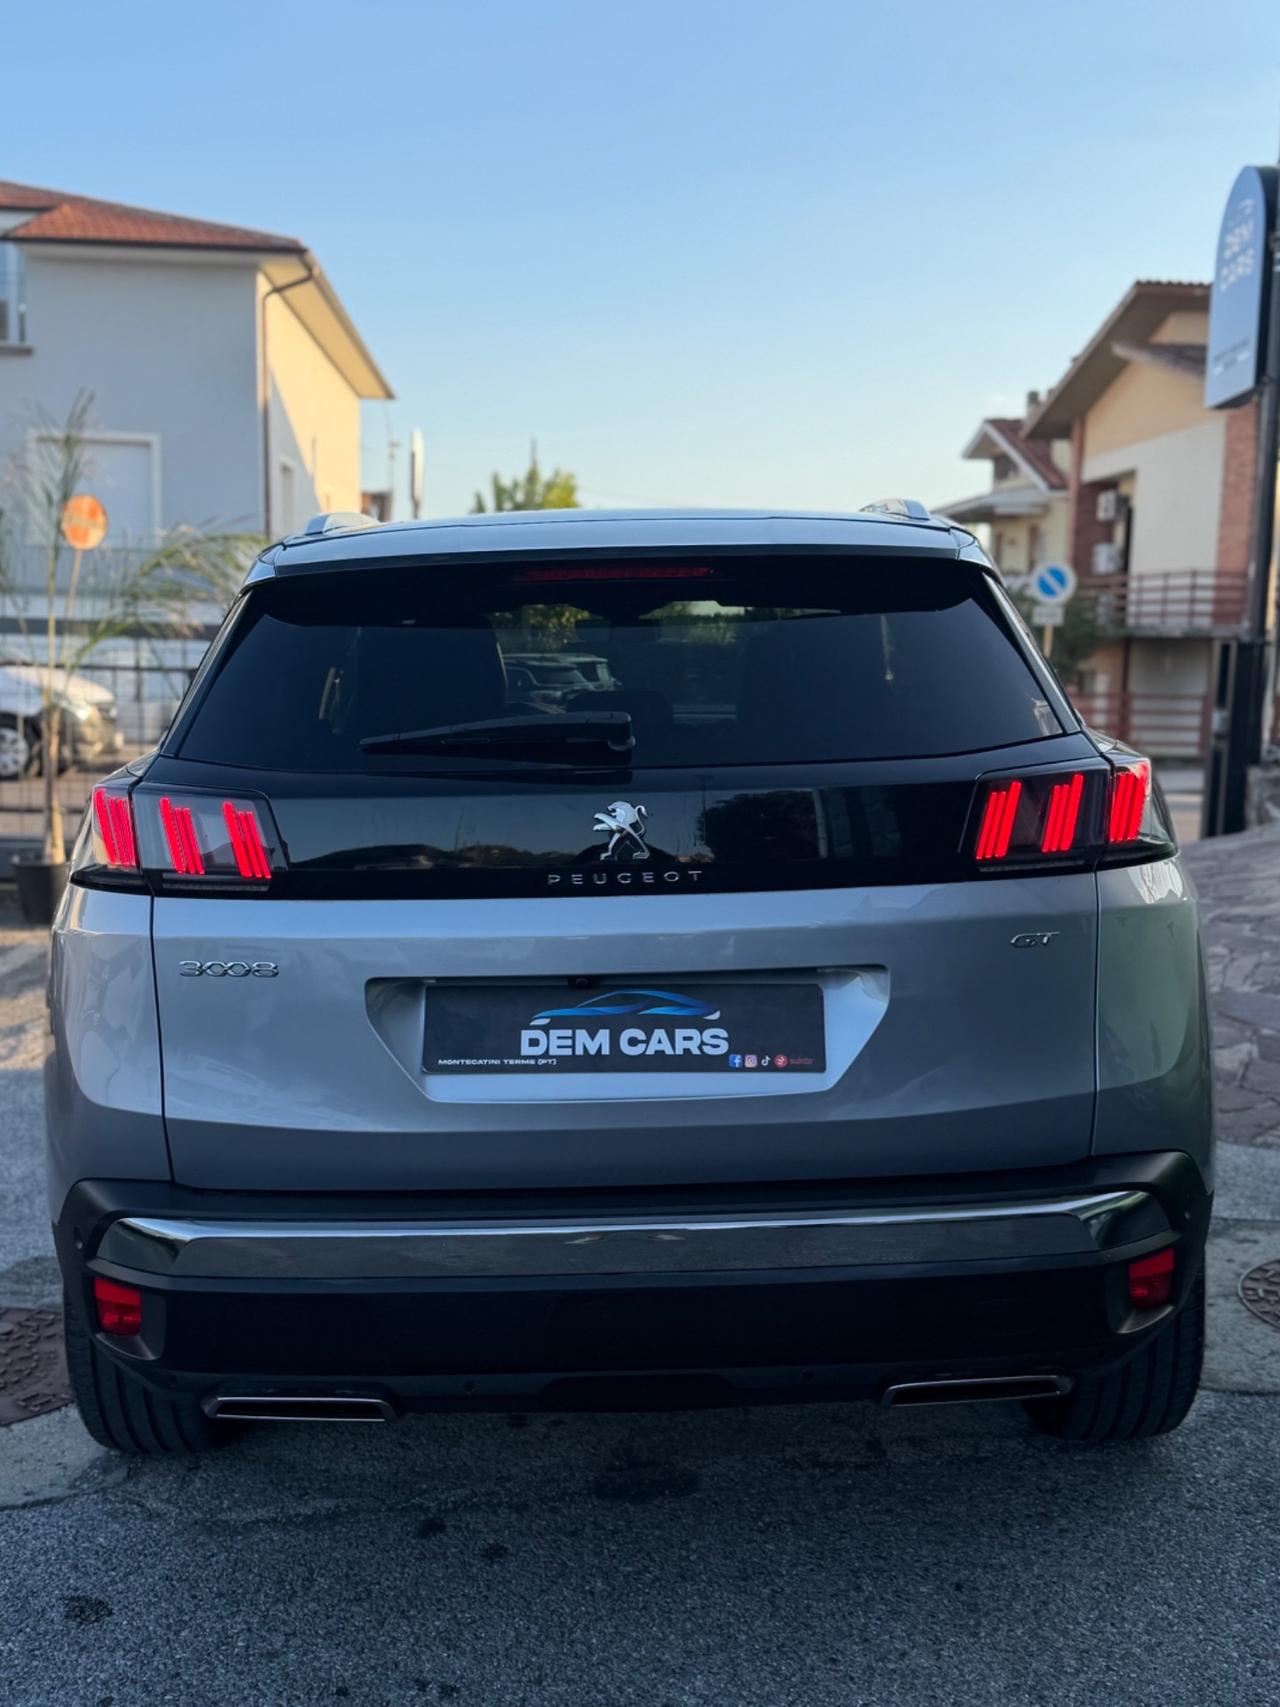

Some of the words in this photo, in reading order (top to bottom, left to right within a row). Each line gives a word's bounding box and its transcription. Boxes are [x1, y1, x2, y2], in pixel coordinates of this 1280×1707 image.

[547, 870, 702, 885] PEUGEOT
[1010, 931, 1060, 948] GT
[179, 960, 279, 977] 3008
[520, 1029, 610, 1056] DEM
[619, 1028, 730, 1056] CARS
[438, 1058, 501, 1066] MONTECATINI
[504, 1058, 536, 1066] TERME
